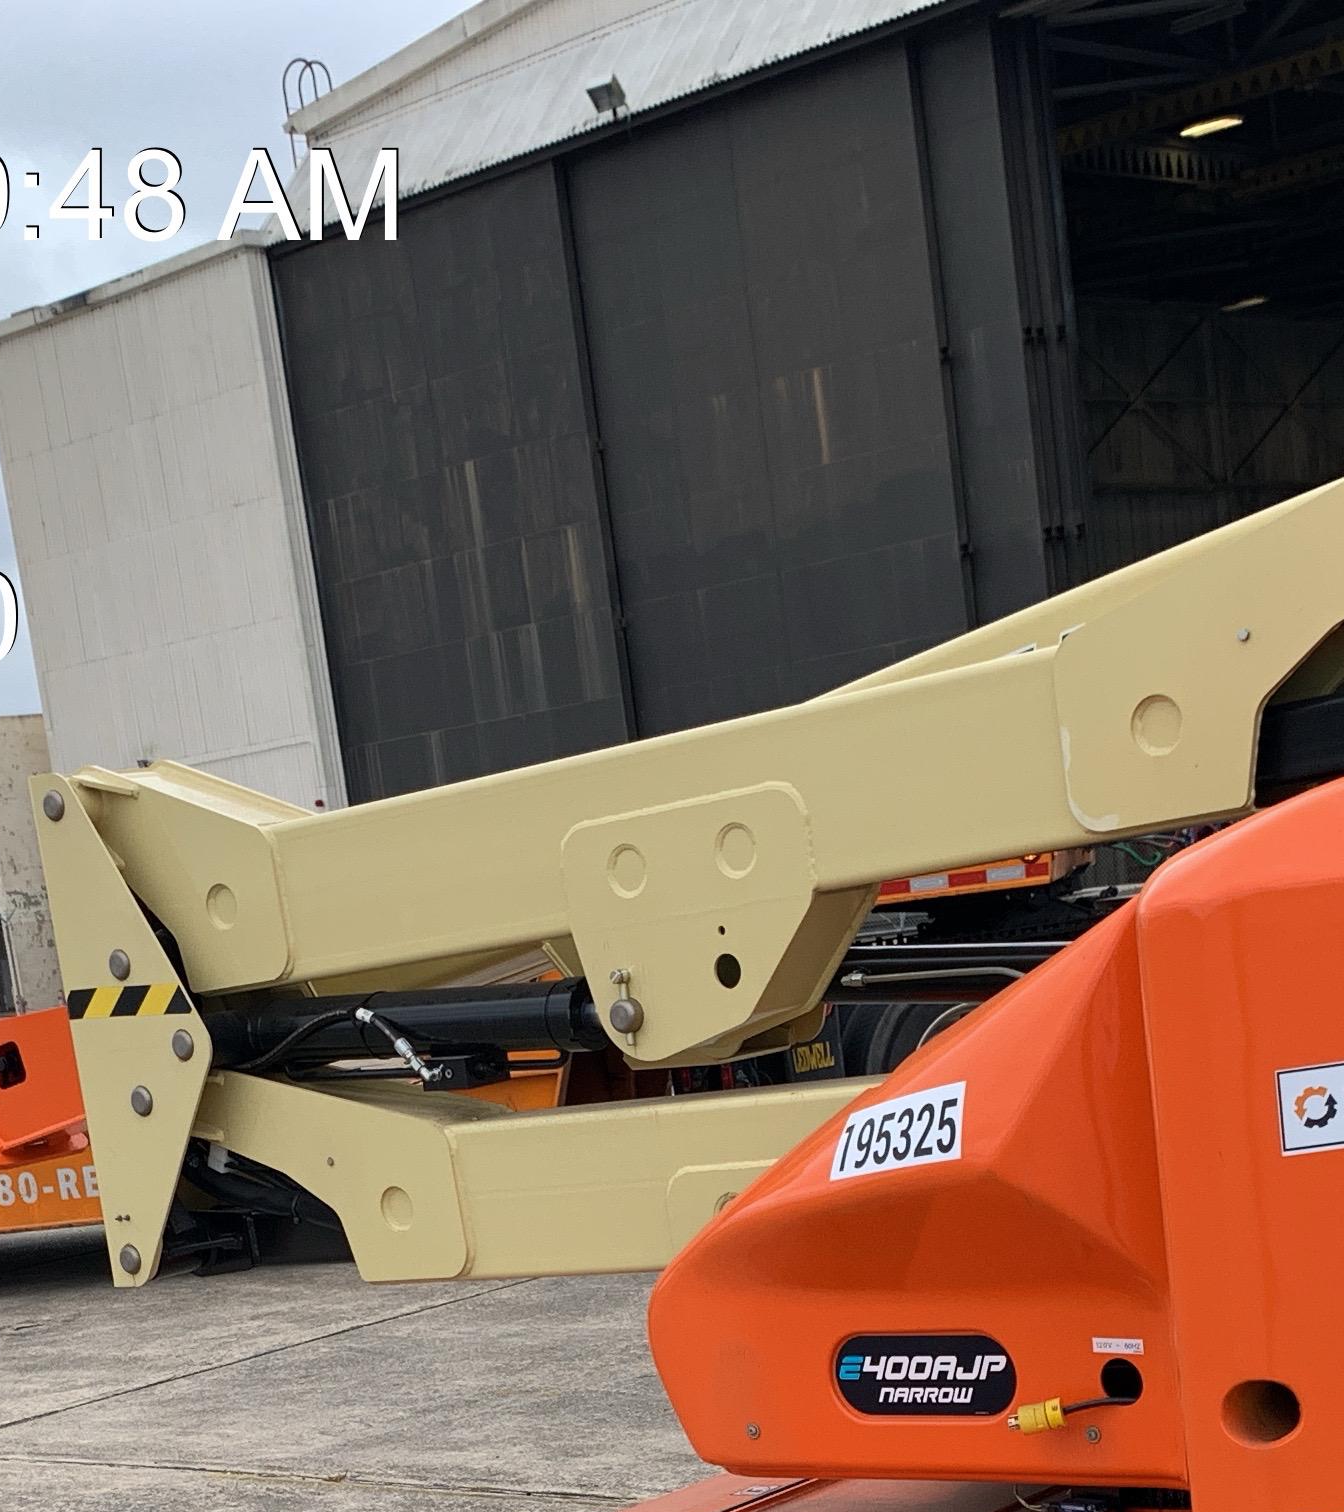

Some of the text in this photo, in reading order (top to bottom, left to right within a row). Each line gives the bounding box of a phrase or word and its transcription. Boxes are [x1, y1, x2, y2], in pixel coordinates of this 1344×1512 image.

[792, 1041, 835, 1073] LEDWELL
[839, 1098, 958, 1173] 195325
[838, 1355, 1007, 1381] E400AJP
[878, 1387, 973, 1404] NARROW
